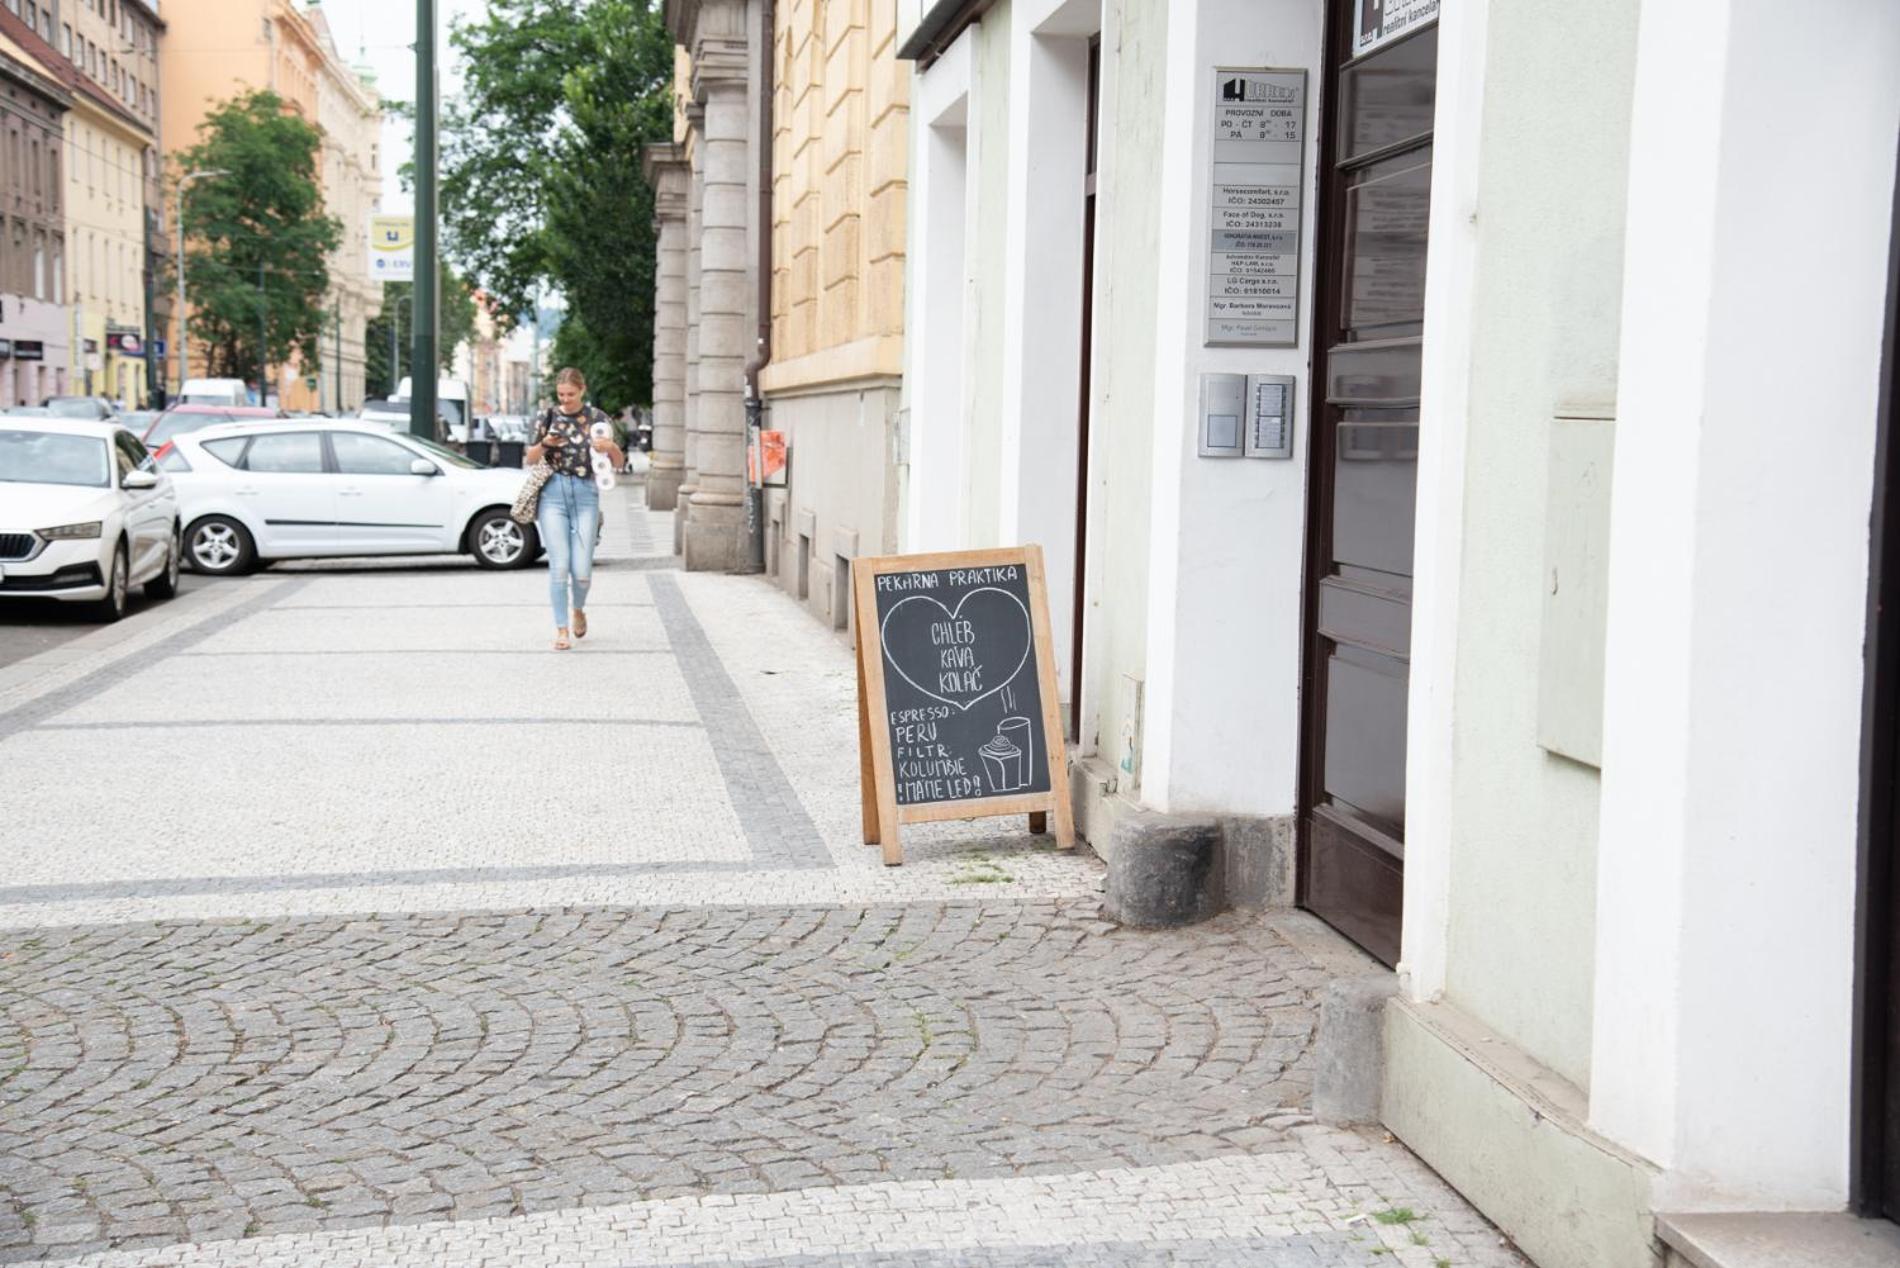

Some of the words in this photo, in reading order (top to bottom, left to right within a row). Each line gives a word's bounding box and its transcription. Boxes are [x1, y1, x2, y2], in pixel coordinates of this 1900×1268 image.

[1270, 108, 1293, 118] DOBA
[1220, 119, 1233, 128] PO
[1285, 120, 1297, 130] 17
[1285, 131, 1296, 139] 15
[1224, 286, 1241, 294] IČO:
[949, 565, 1018, 587] PRAKTIKA
[899, 757, 968, 779] KOLUMBIE
